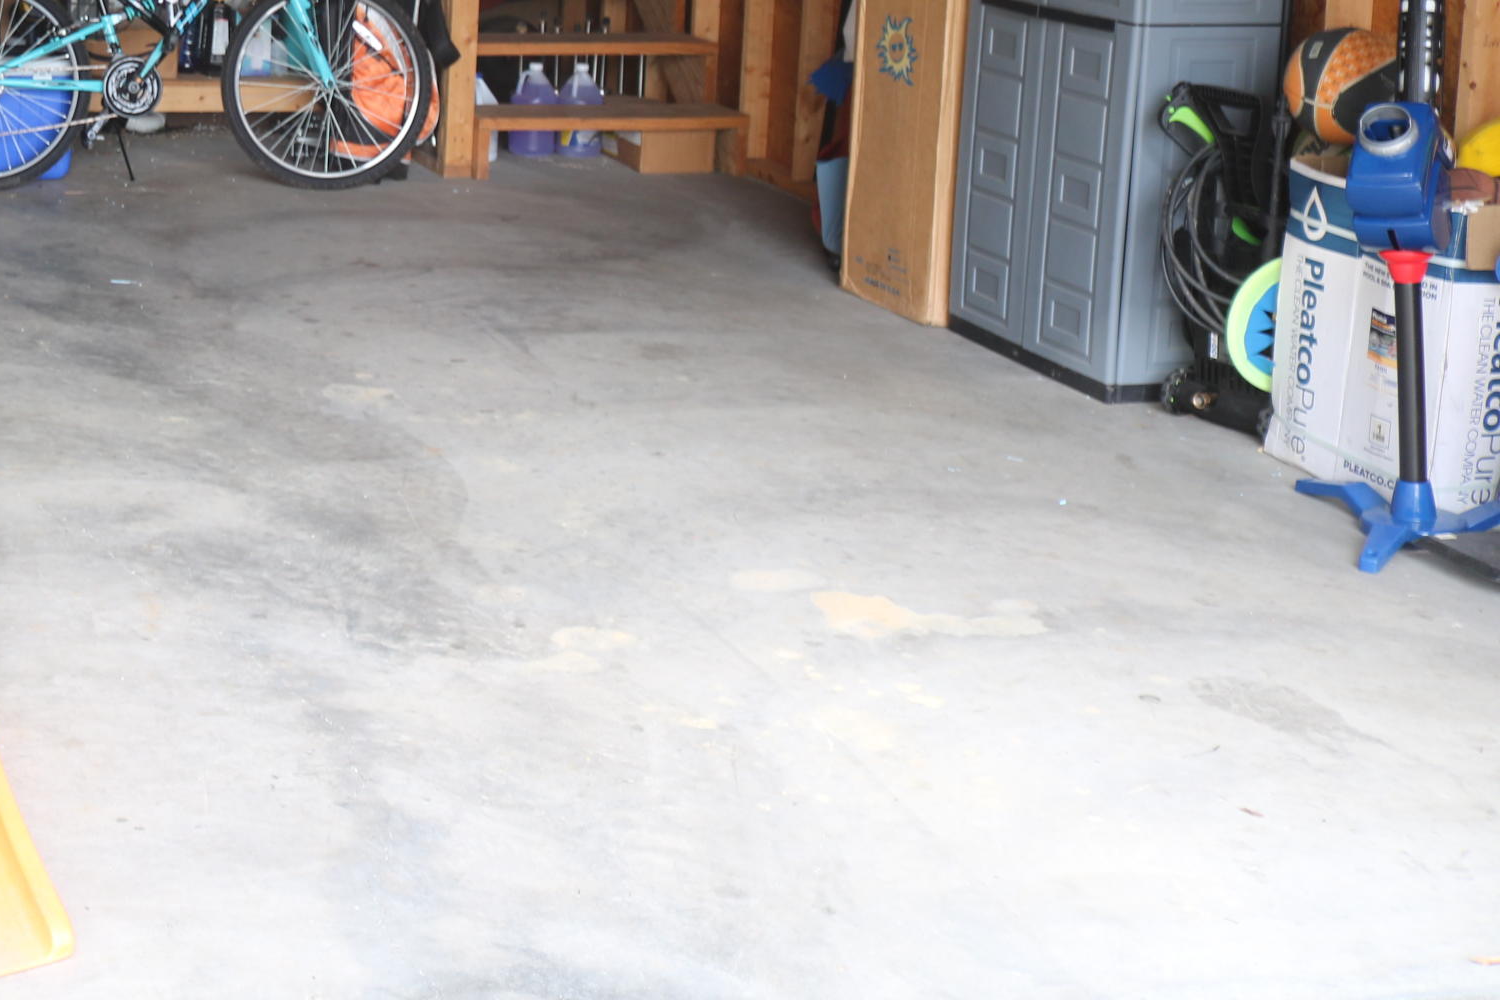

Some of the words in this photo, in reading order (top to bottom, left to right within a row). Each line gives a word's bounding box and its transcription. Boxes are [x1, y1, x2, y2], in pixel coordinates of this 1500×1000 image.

[1481, 298, 1496, 321] THE
[1476, 326, 1493, 375] CLEAN
[1469, 379, 1485, 425] WATER
